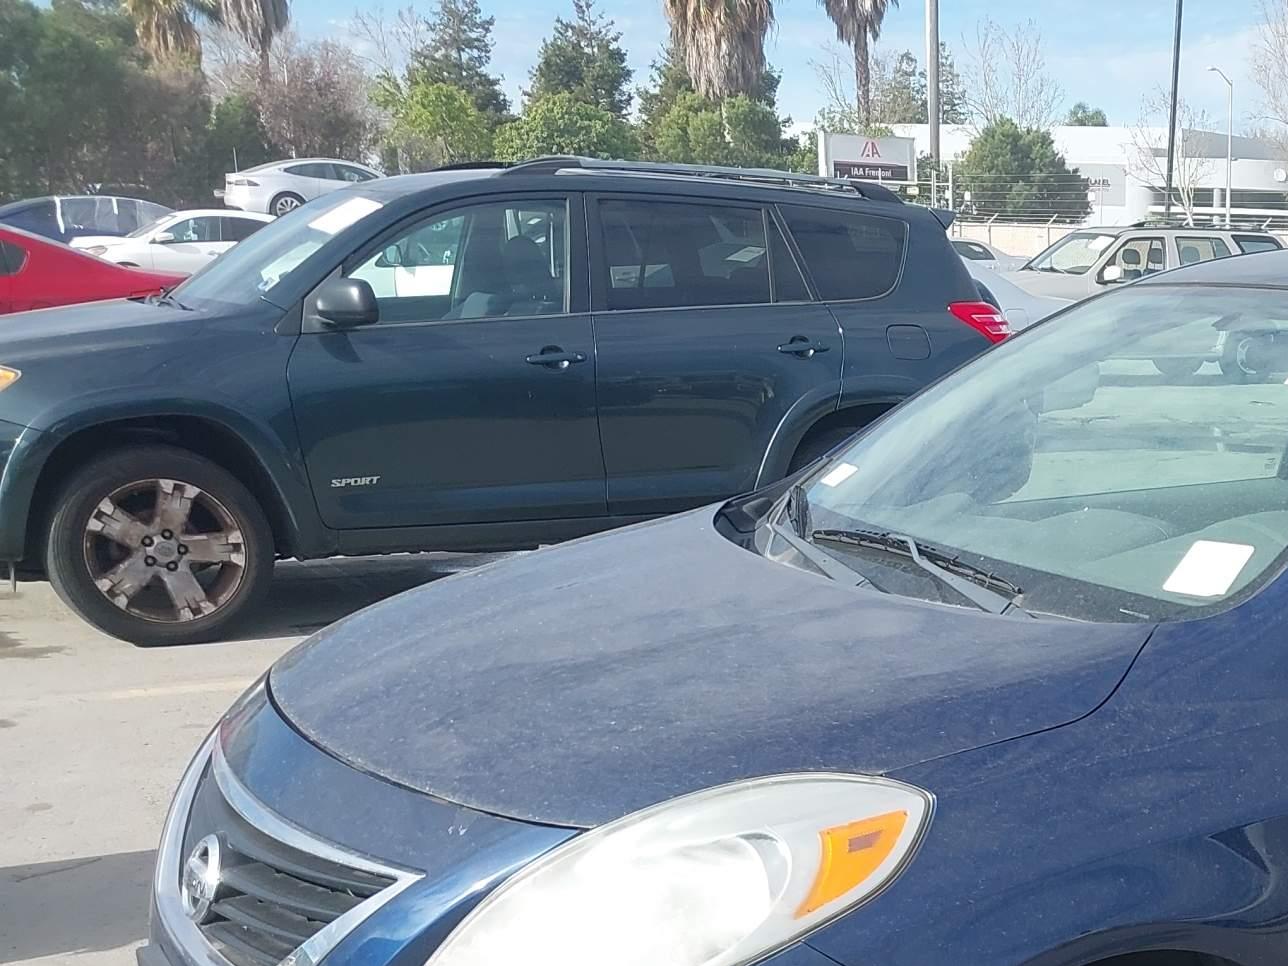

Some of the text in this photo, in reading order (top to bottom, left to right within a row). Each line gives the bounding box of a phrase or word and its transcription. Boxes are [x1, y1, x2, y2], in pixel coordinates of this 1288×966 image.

[851, 167, 892, 177] IAA Fremont
[331, 475, 381, 488] SPORT
